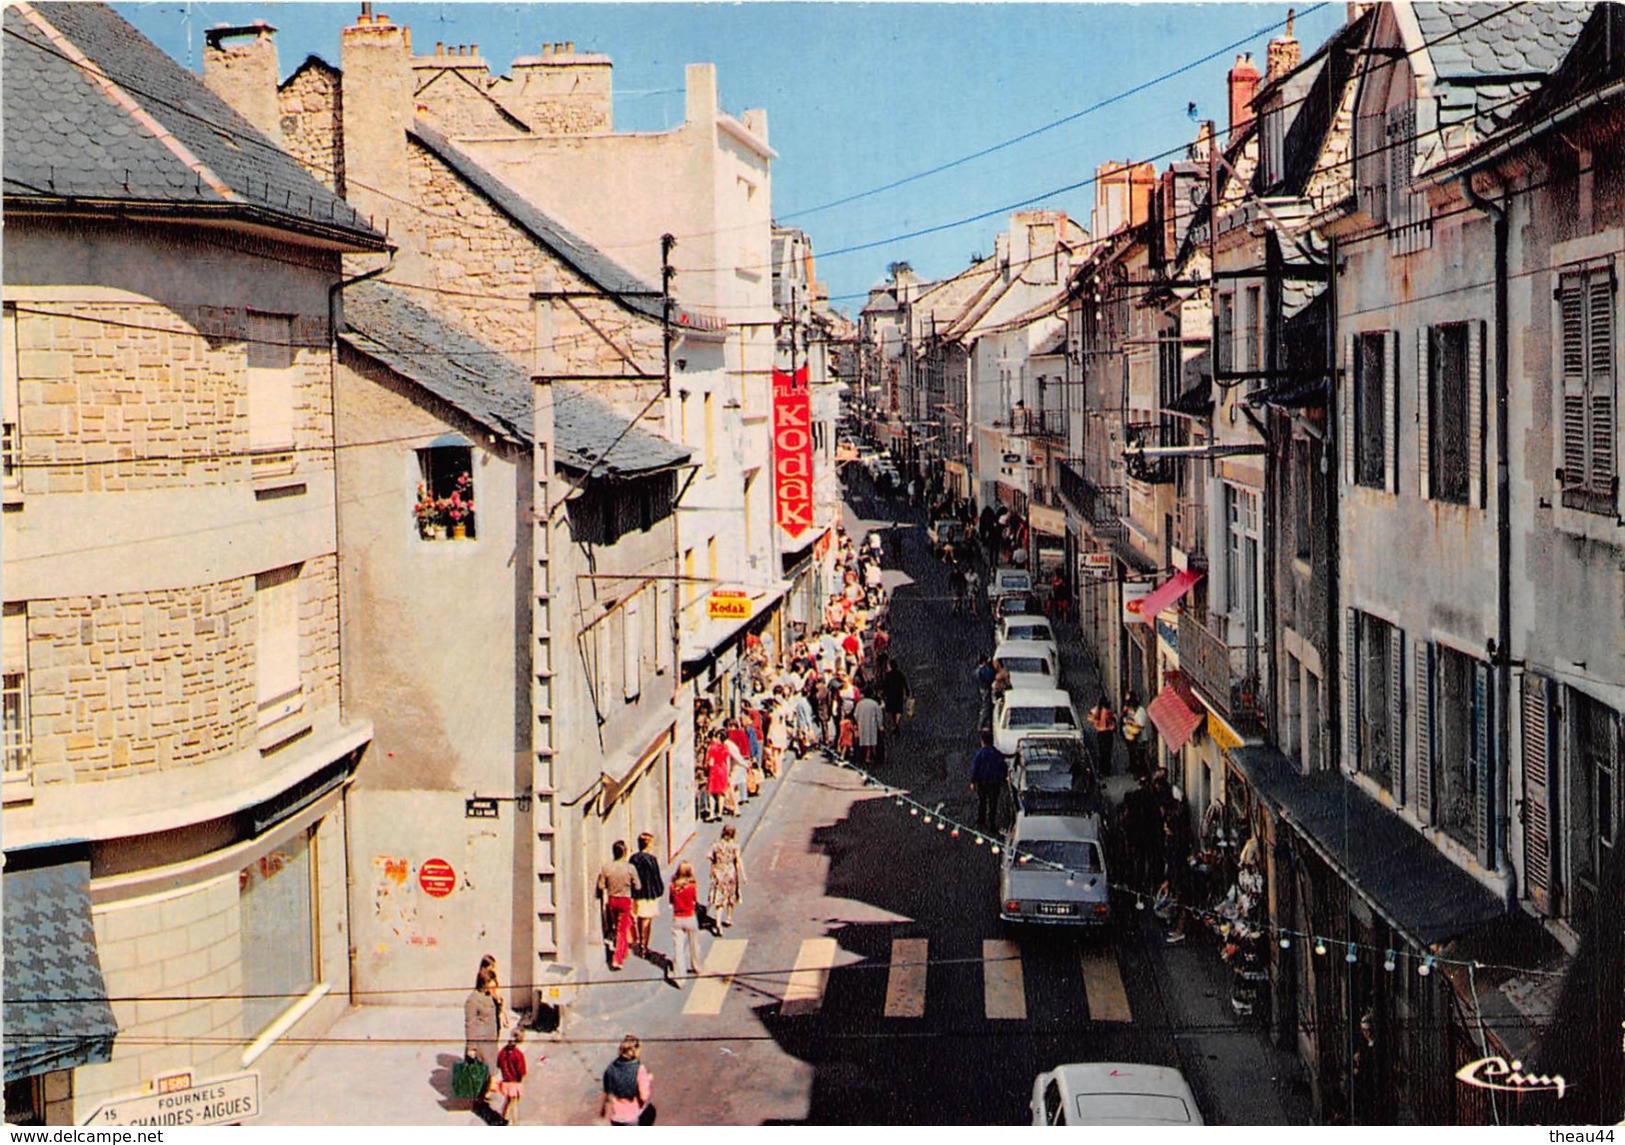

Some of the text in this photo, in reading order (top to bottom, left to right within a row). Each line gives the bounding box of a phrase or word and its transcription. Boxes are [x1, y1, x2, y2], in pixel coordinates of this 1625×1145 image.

[710, 601, 746, 614] Kodak
[158, 1087, 226, 1109] FOURNELS
[104, 1109, 117, 1120] 15
